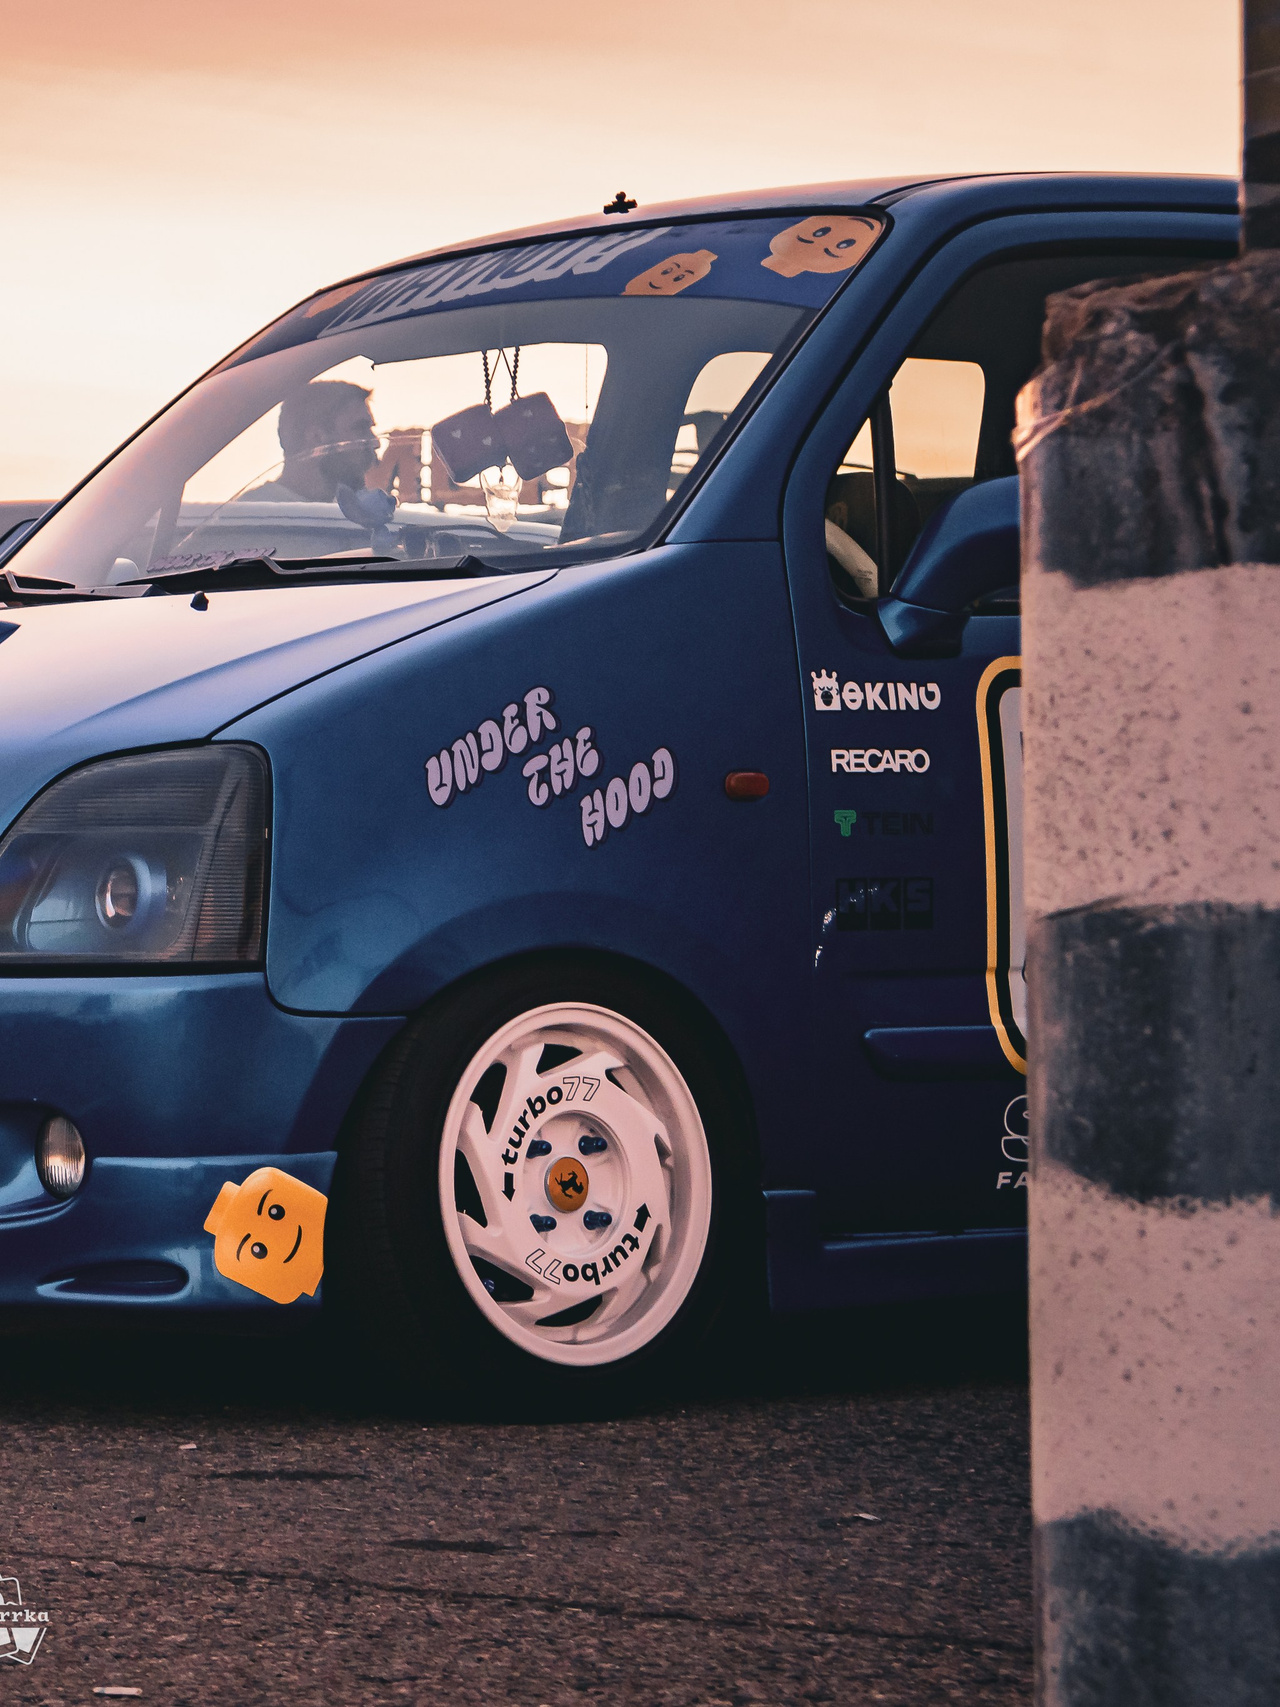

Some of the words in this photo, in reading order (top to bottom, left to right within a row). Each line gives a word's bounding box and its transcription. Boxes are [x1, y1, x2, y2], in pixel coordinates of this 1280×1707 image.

[424, 686, 559, 807] UNDER
[522, 726, 601, 807] THE
[831, 748, 930, 773] RECARO
[580, 747, 677, 848] HOOD
[862, 812, 934, 836] TEIN
[837, 878, 932, 918] HKS
